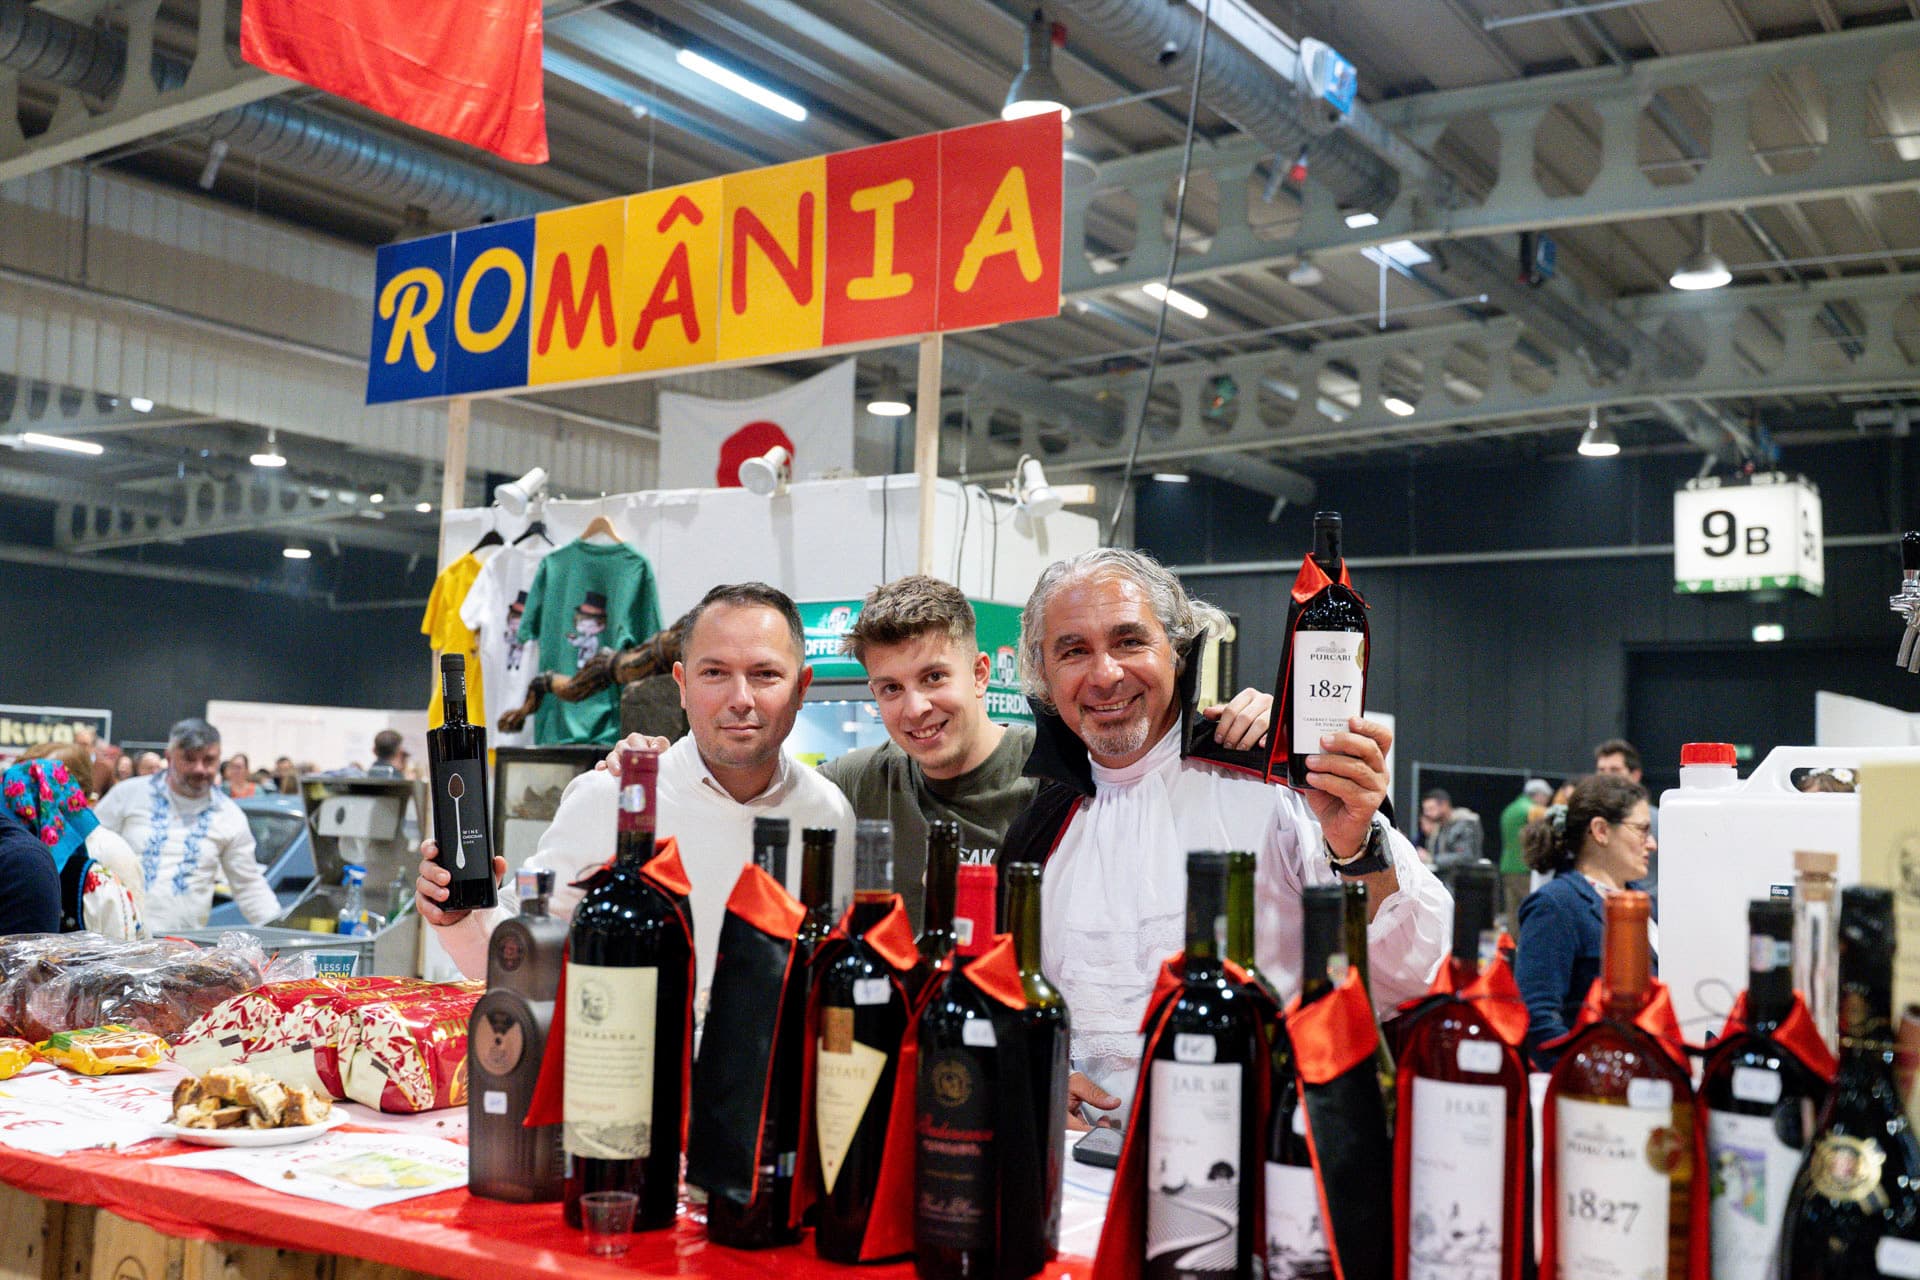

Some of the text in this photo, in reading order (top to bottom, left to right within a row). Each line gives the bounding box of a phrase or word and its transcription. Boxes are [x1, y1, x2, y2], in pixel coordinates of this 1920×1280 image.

[379, 167, 1042, 373] ROMÂNIA
[1309, 679, 1352, 703] 1827
[320, 963, 351, 971] LESS IS
[1567, 1188, 1641, 1235] 1827
